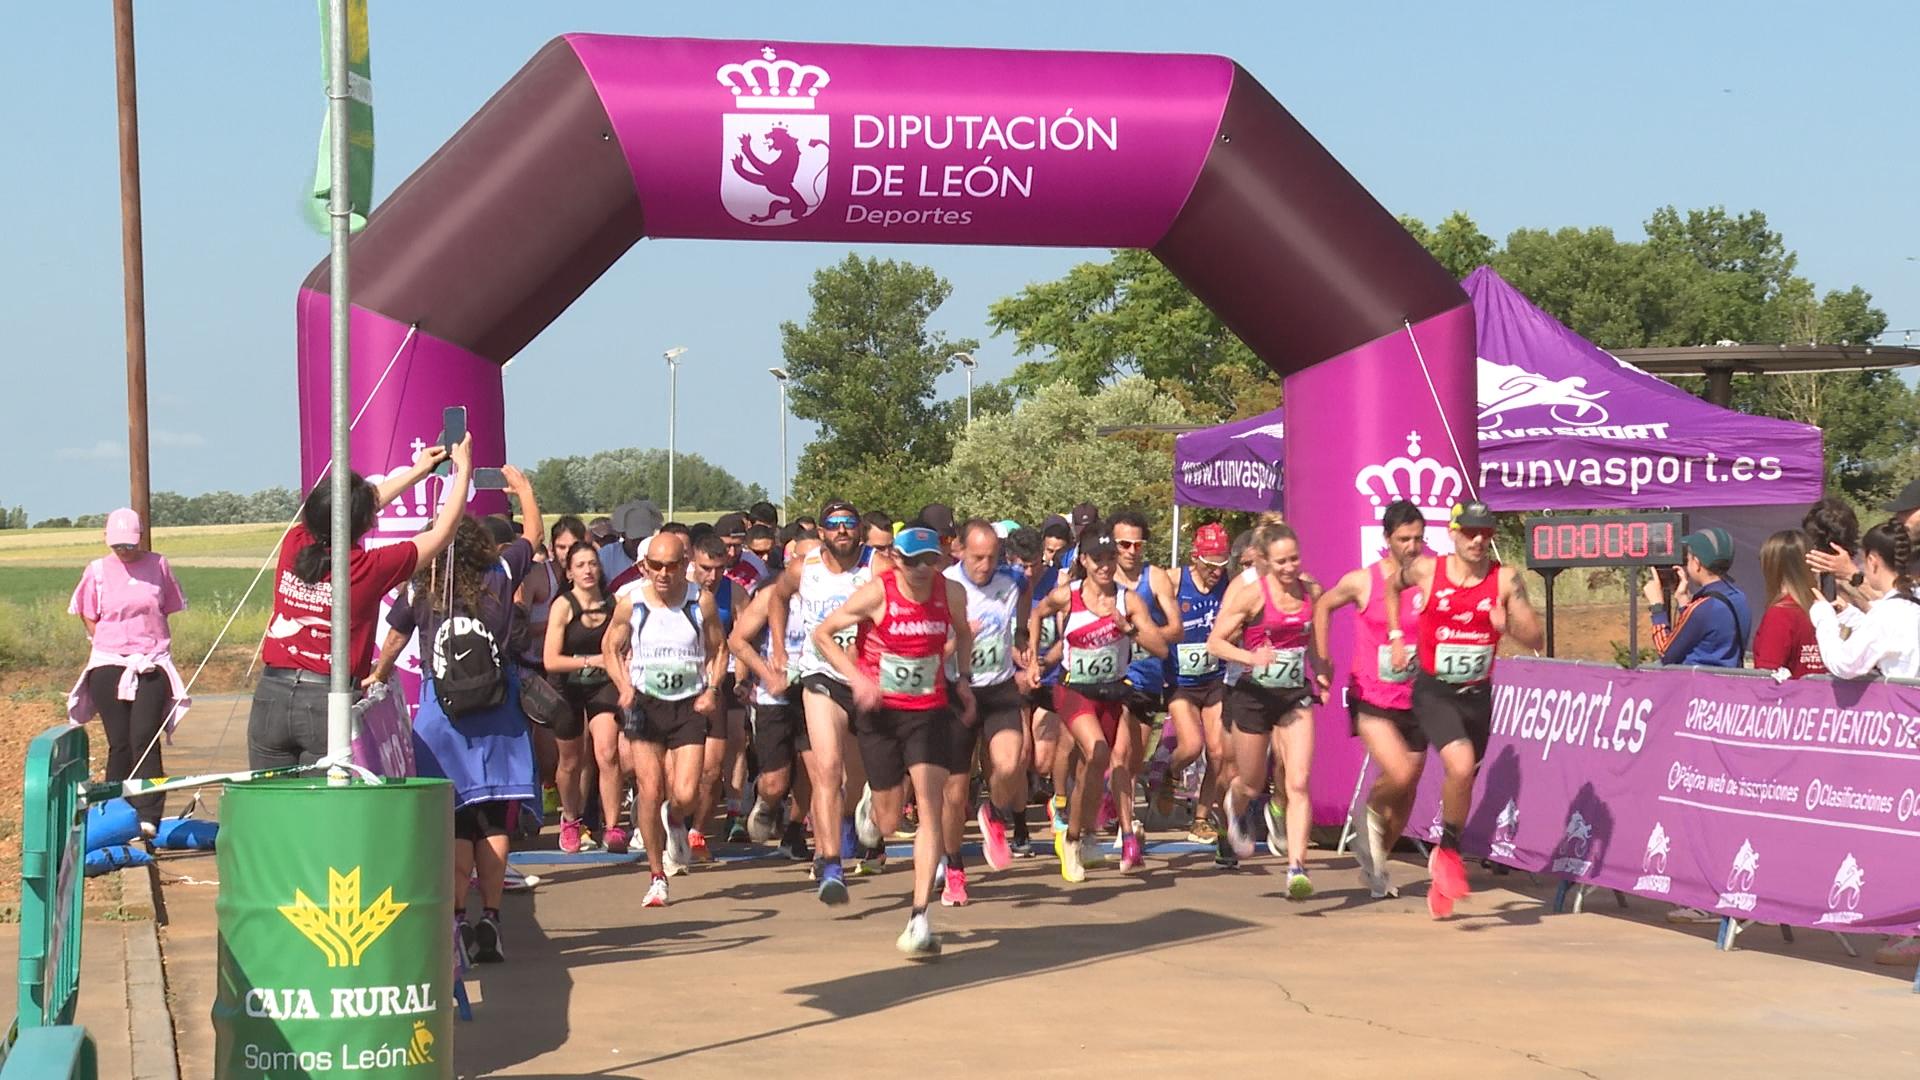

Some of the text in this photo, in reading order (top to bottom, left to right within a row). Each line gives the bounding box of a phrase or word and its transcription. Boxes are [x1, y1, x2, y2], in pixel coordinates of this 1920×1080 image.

[853, 109, 1118, 151] DIPUTACIÓN
[850, 156, 1033, 198] DE LEÓN
[845, 204, 972, 226] Deportes
[1478, 423, 1670, 441] NVASPORT
[1479, 452, 1783, 495] runvasport.es
[1532, 522, 1674, 560] 00:00:01
[453, 616, 488, 638] DO
[1076, 656, 1113, 677] 163
[1189, 651, 1211, 669] 91
[1258, 660, 1301, 681] 176
[1443, 654, 1489, 676] 153
[656, 671, 684, 690] 38
[895, 666, 925, 689] 95
[1489, 681, 1653, 761] unvasport.es
[1793, 706, 1819, 742] DE
[1818, 708, 1896, 748] EVENTOS
[1820, 784, 1894, 814] Clasificaciones
[245, 983, 437, 1020] CAJA RURAL
[245, 1043, 408, 1071] Somos León
